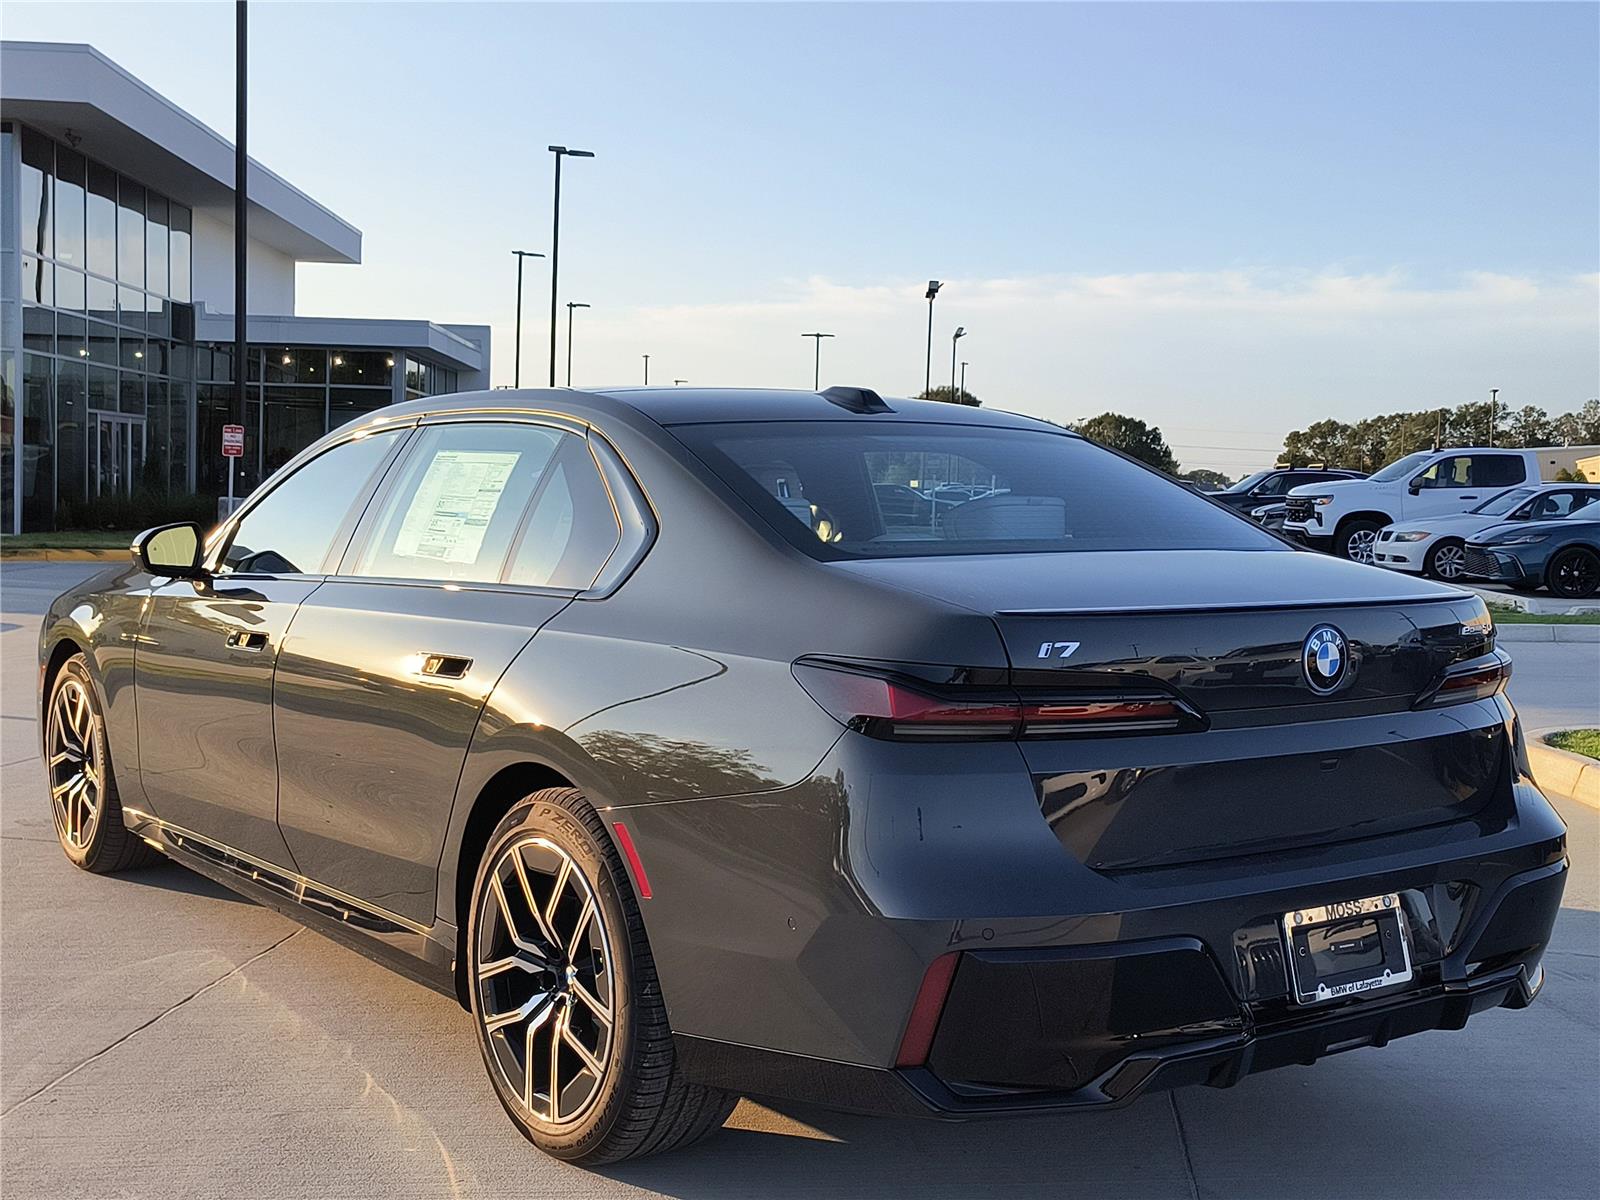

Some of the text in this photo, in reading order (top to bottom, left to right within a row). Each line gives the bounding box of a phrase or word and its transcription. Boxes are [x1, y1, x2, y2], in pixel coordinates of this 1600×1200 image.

[1038, 642, 1080, 658] i7
[1310, 631, 1343, 651] BMW
[552, 812, 593, 856] ZERO
[1325, 901, 1362, 920] MOSS
[1330, 979, 1383, 996] BMW of Lafayette
[576, 1129, 594, 1147] R20
